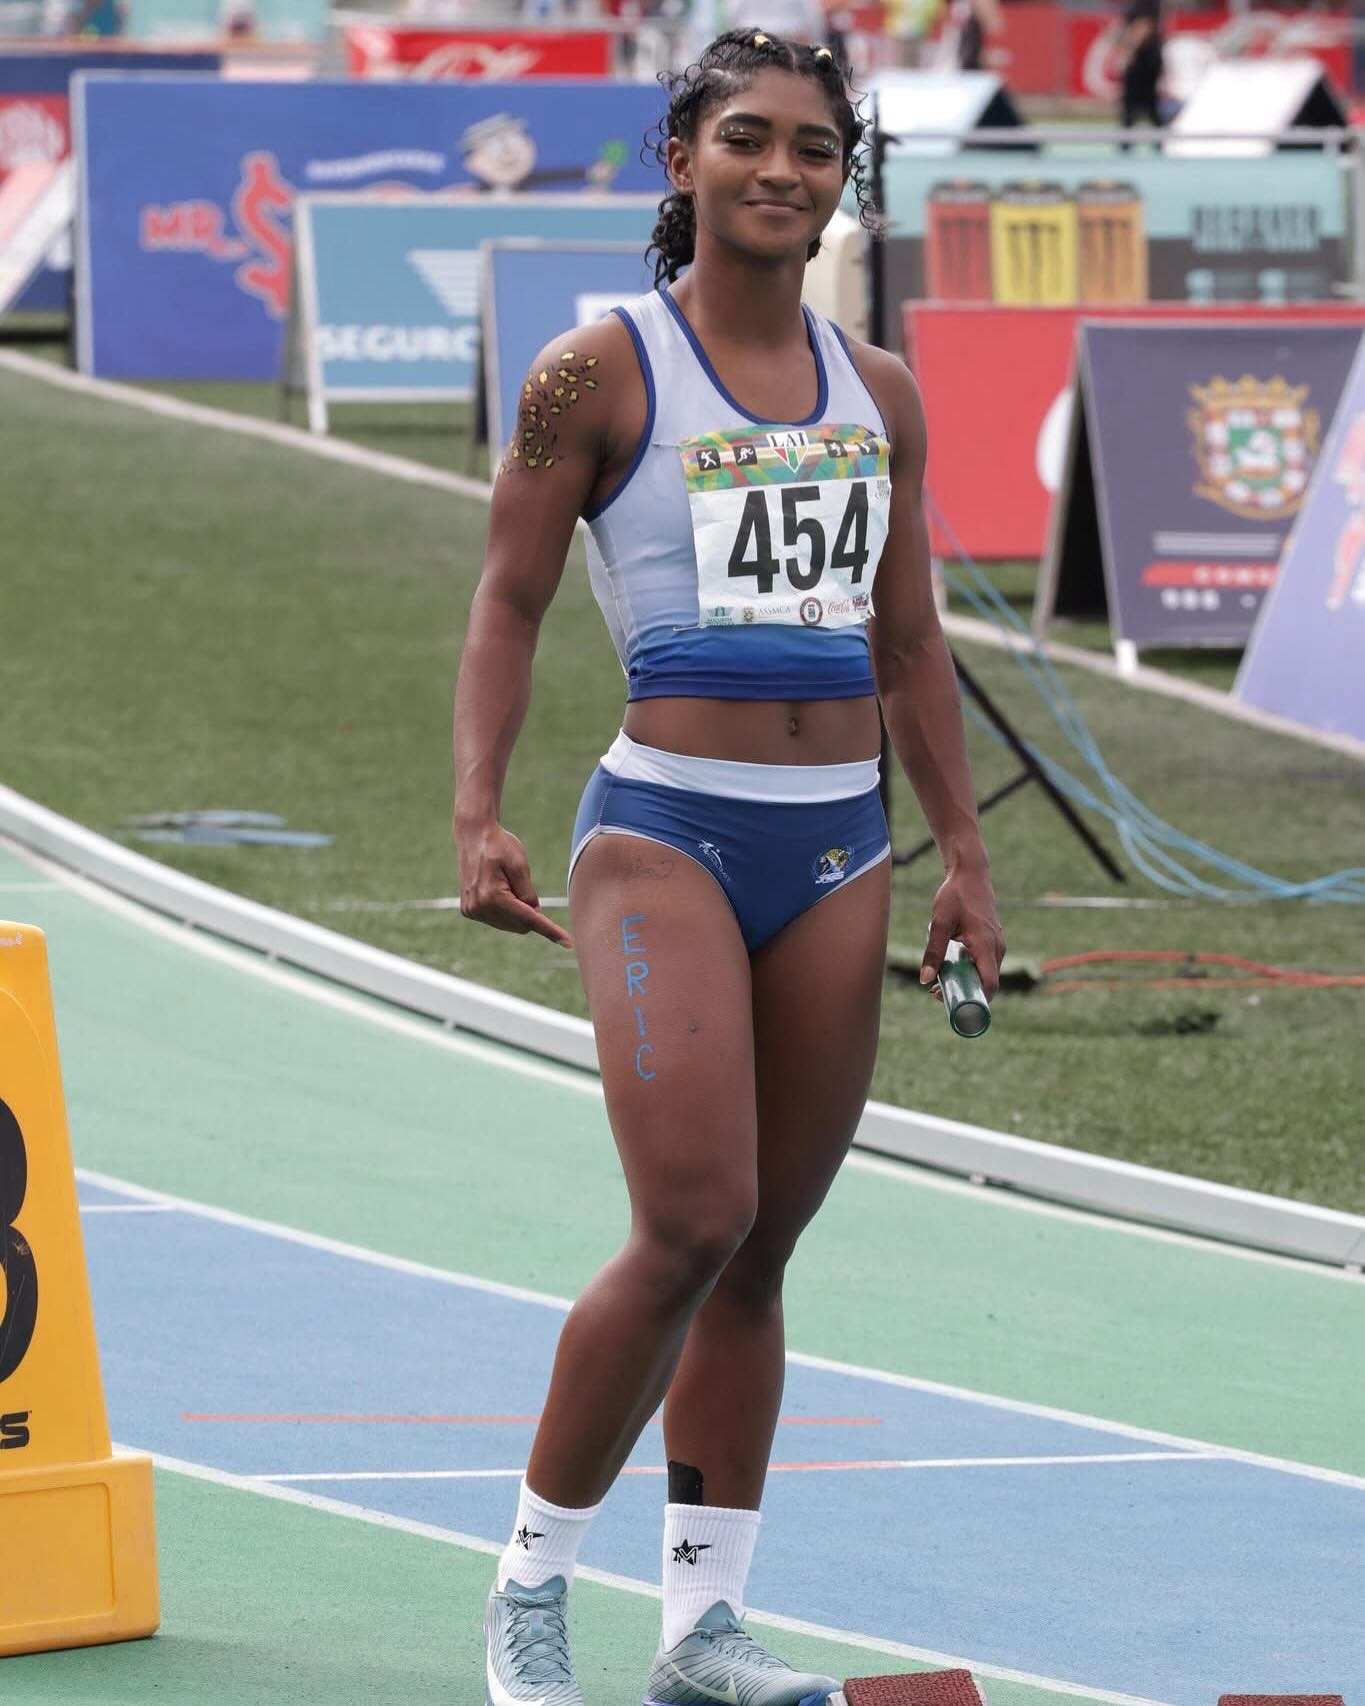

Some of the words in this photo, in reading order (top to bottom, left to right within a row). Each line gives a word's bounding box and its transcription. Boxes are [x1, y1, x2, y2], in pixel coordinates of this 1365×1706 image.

[769, 431, 805, 448] LAI
[728, 481, 870, 594] 454
[621, 913, 656, 1081] ERIC
